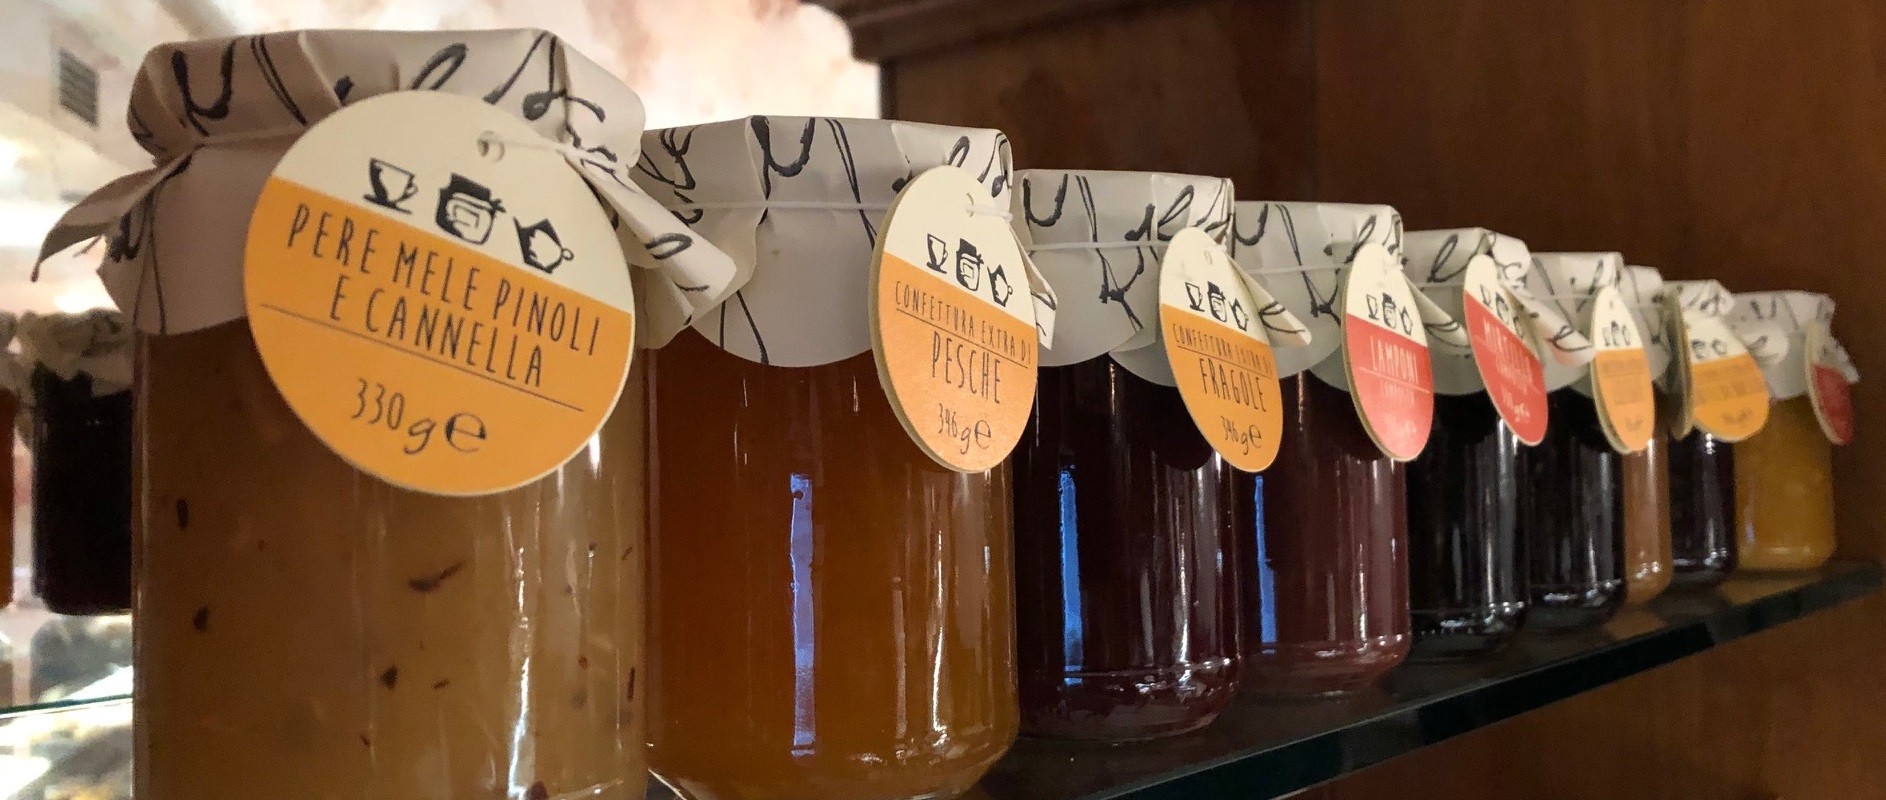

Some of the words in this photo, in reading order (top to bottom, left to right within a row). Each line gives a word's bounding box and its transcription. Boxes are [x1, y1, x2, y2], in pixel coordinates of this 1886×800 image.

[287, 204, 377, 273] PERE
[393, 241, 480, 310] MELE
[493, 278, 600, 356] PINOLI
[330, 275, 347, 321] E
[365, 287, 541, 388] CANNELLA
[895, 280, 975, 338] CONFETTURA
[981, 320, 1016, 356] EXTRA
[1021, 340, 1031, 364] DI
[1173, 323, 1233, 359] CONFETTURA
[932, 331, 1001, 404] PESCHE
[1200, 358, 1267, 412] FRAGOLE
